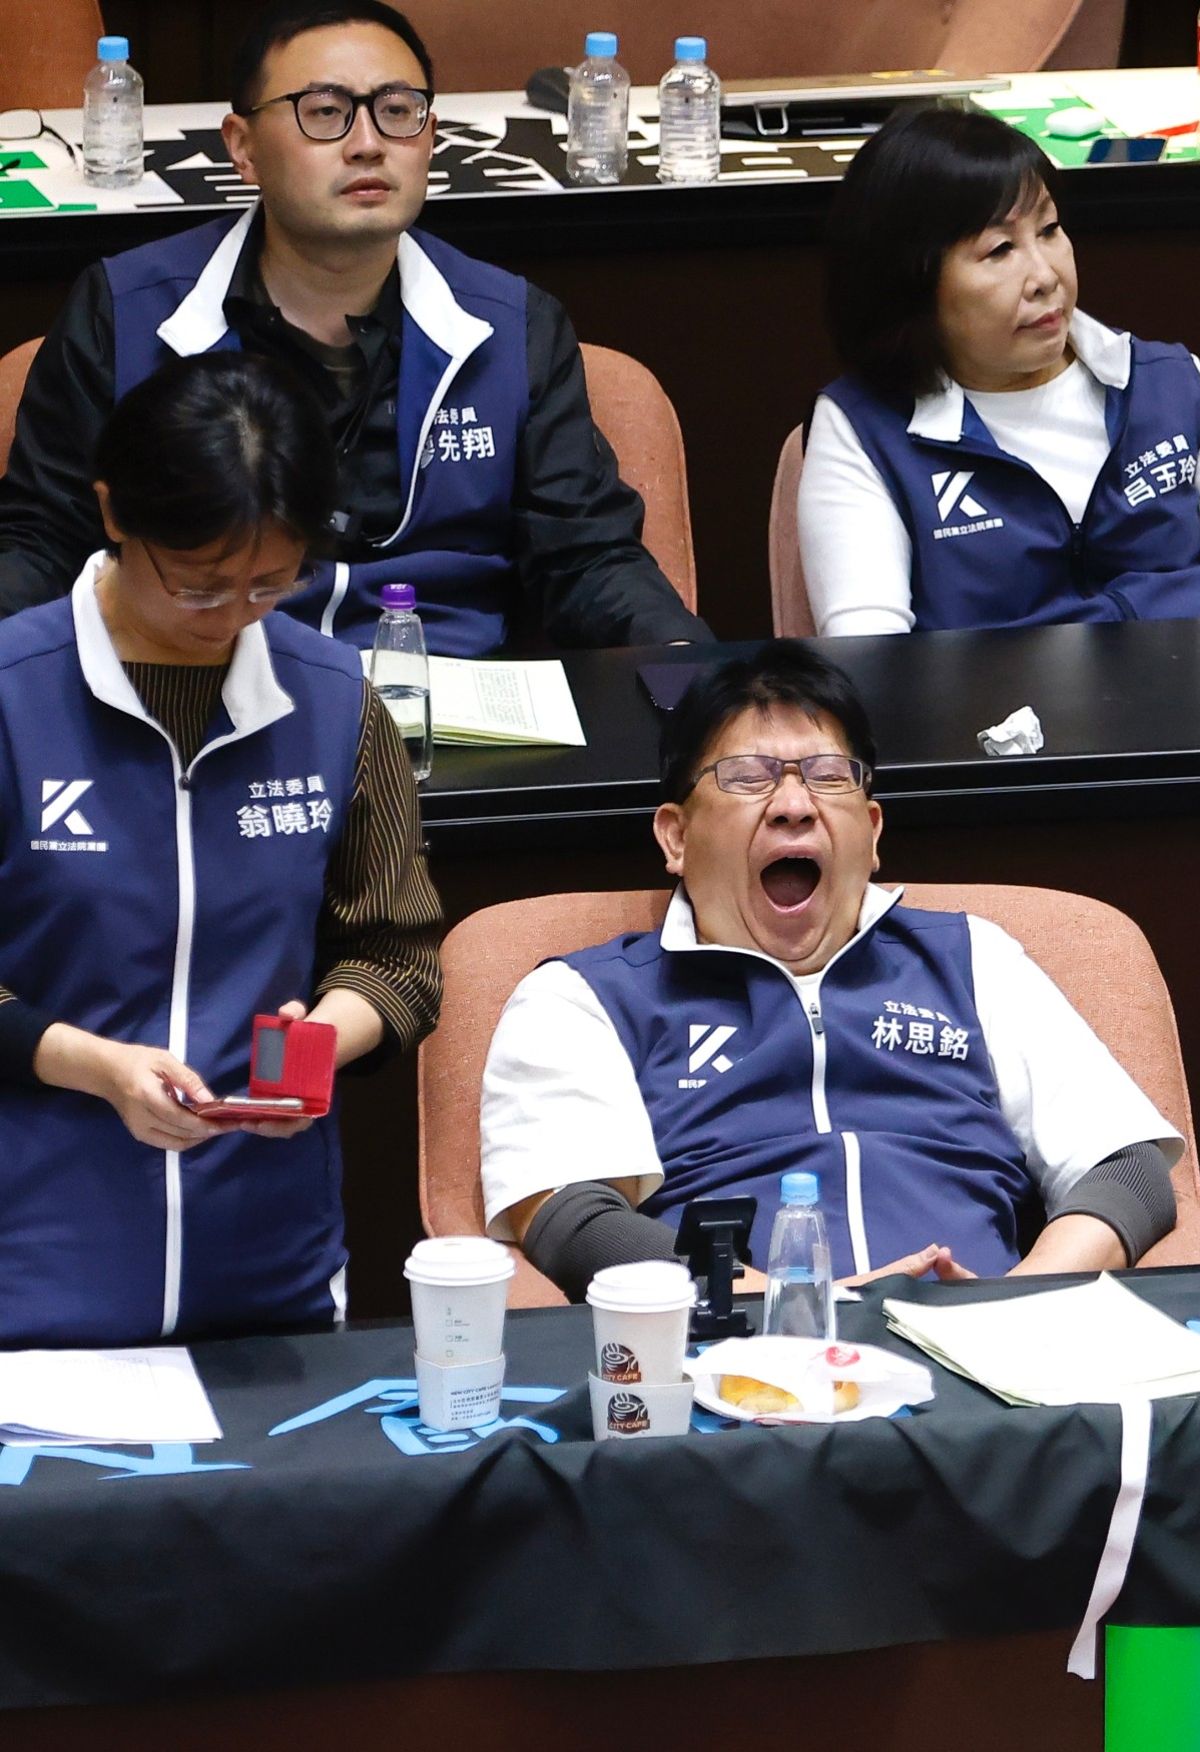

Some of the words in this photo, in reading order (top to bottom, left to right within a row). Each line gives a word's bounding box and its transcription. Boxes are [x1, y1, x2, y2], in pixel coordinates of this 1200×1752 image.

[434, 406, 478, 425] 法委員
[1123, 434, 1190, 479] 立法委員
[1123, 454, 1197, 507] 呂玉玲
[248, 775, 326, 799] 立法委員
[236, 798, 334, 839] 翁曉玲
[871, 1015, 970, 1060] 林思銘
[617, 1373, 638, 1381] CAFE
[626, 1420, 647, 1429] CAFE
